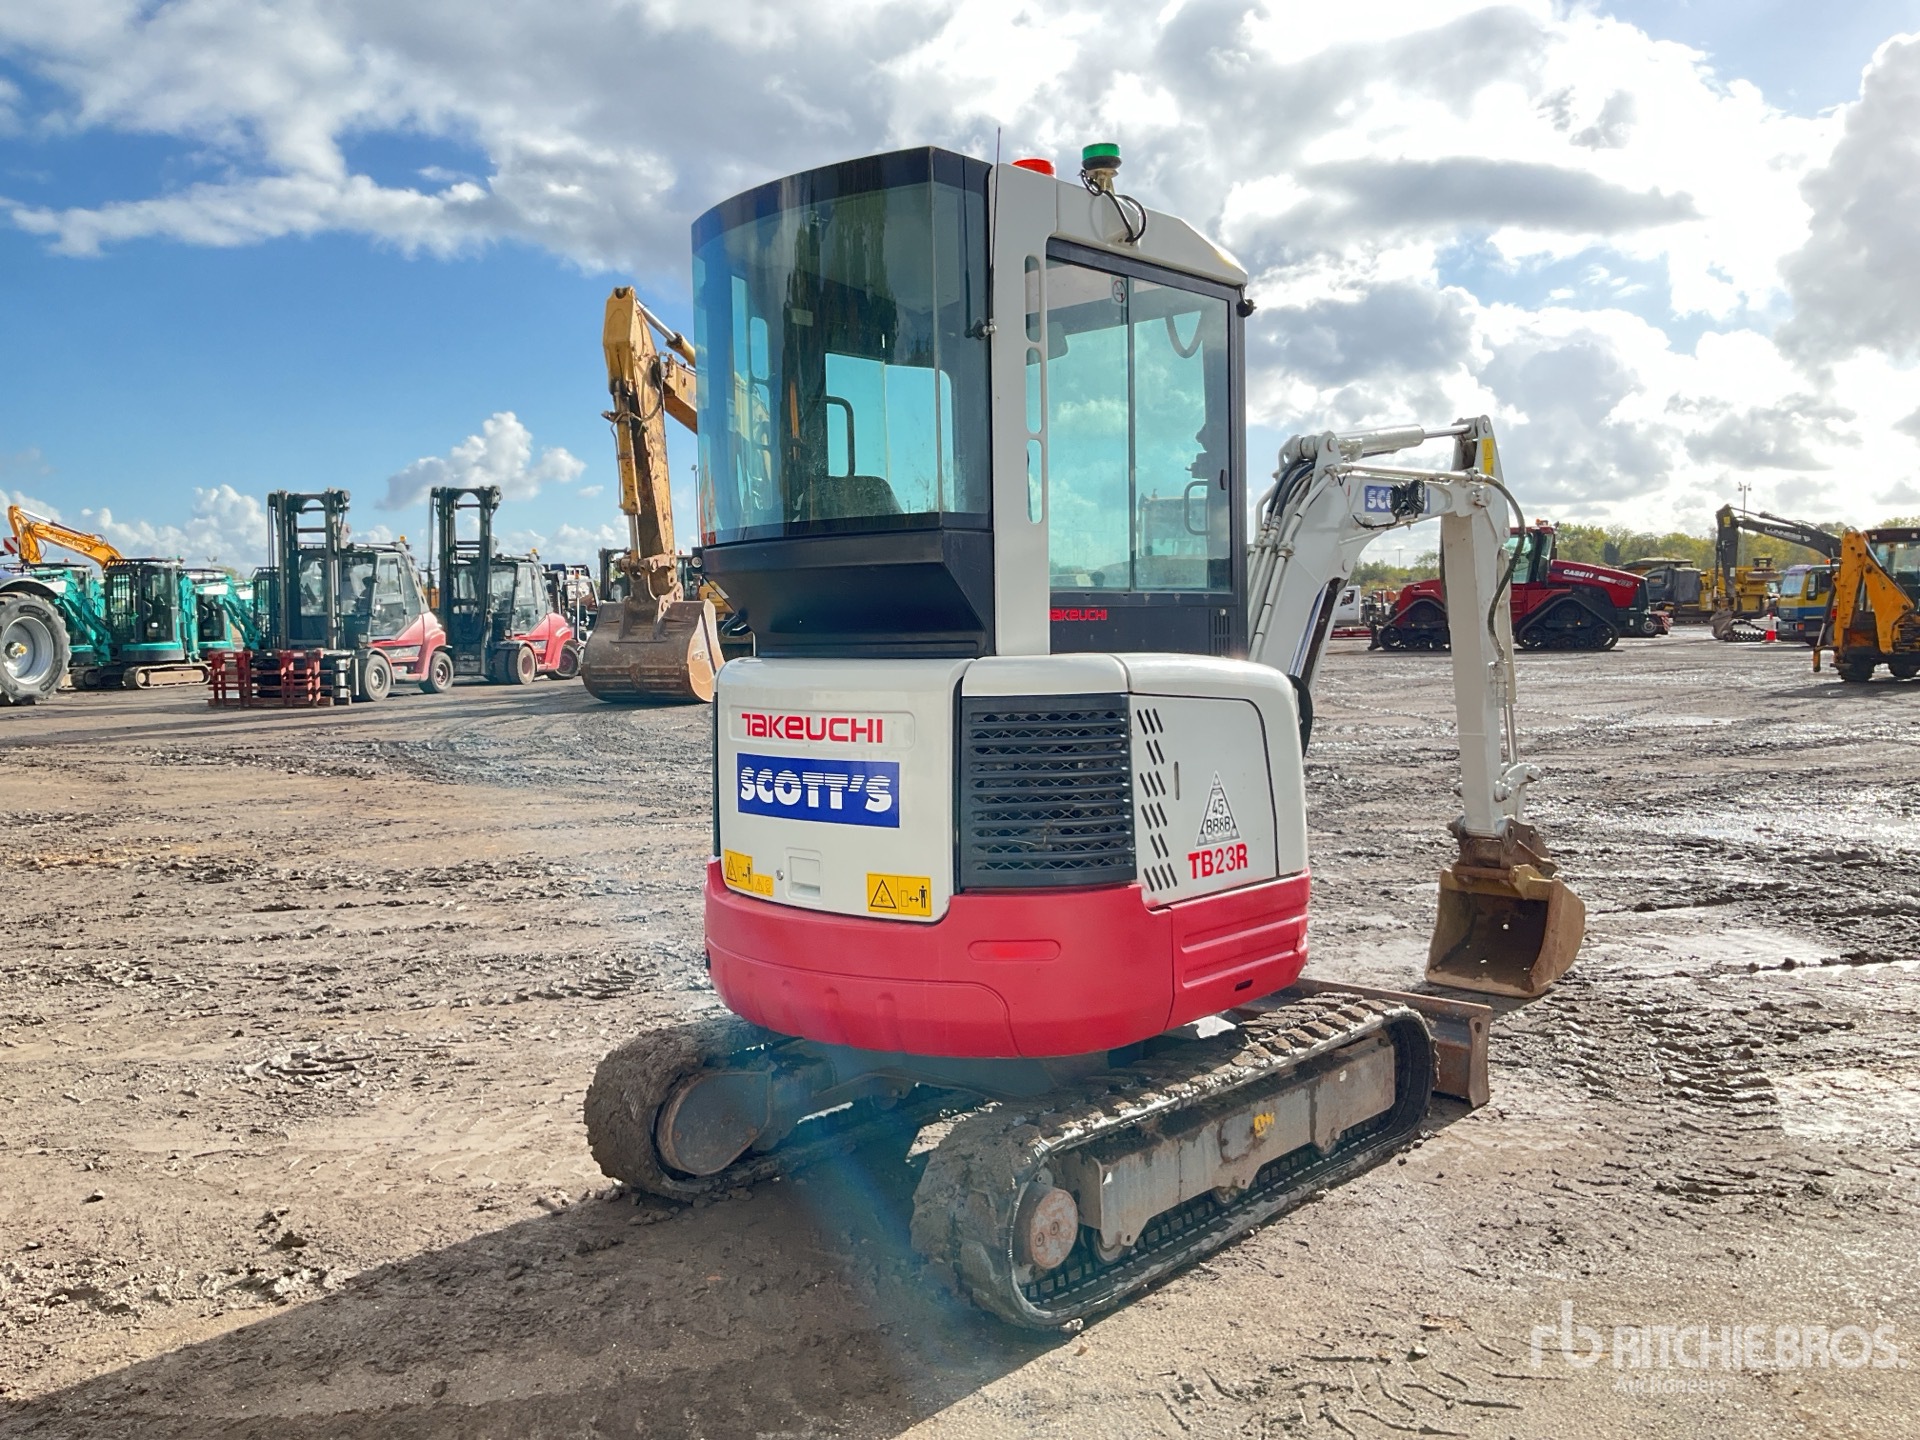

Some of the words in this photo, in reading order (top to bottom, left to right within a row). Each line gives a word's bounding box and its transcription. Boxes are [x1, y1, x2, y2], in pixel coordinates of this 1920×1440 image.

[1049, 609, 1107, 621] AKEUCHI
[740, 766, 893, 813] SCOTT'S
[1212, 798, 1224, 815] 45
[1188, 843, 1248, 879] TB23R
